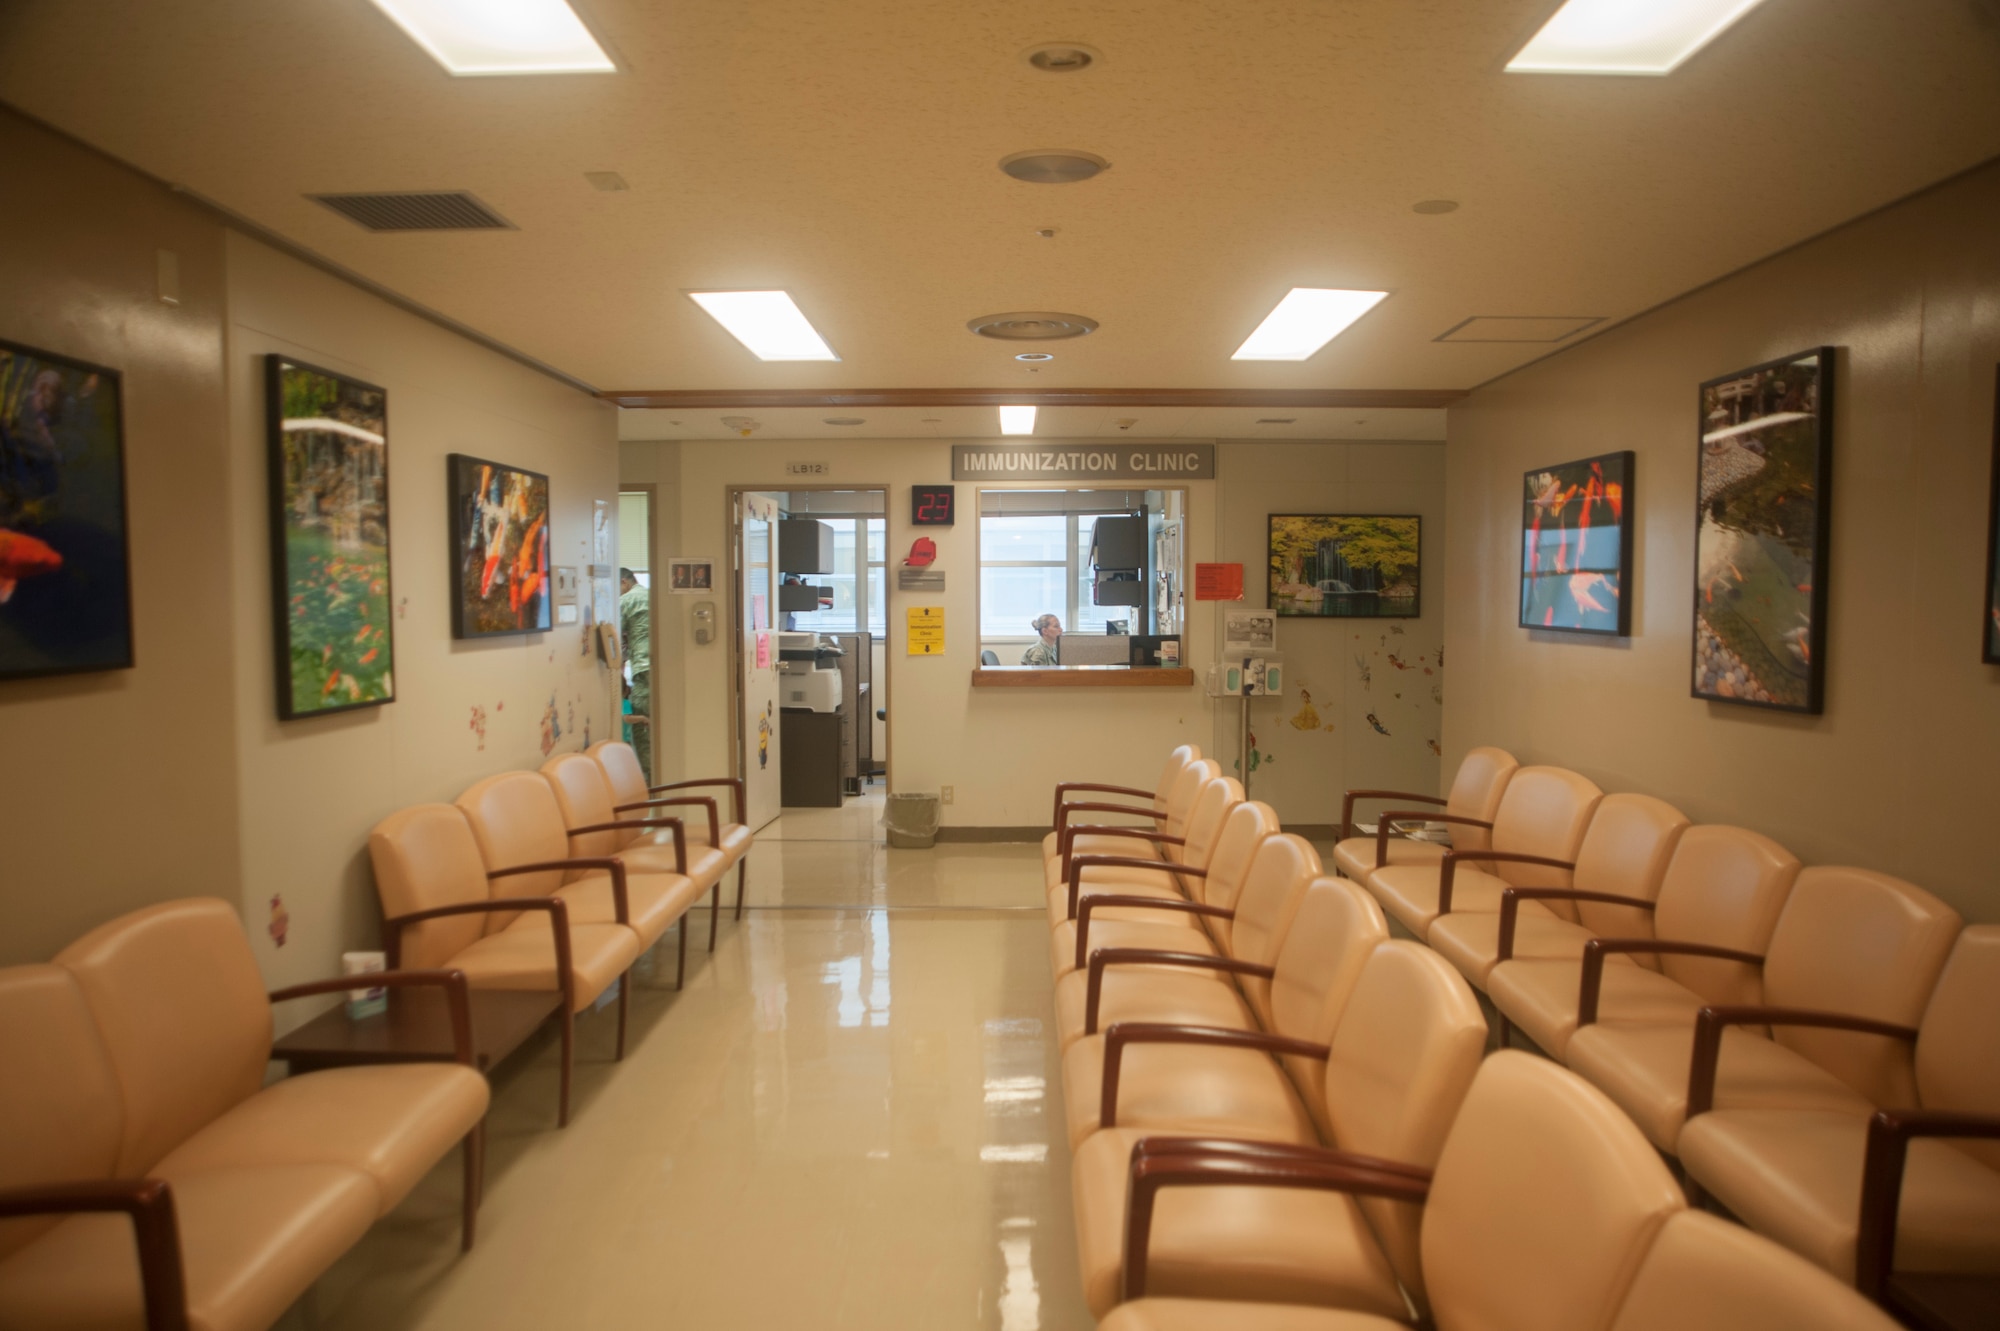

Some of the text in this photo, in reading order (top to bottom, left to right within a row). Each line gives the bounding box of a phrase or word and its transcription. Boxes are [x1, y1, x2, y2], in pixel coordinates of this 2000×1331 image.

[792, 464, 822, 474] LB12
[963, 452, 1199, 471] IMMUNIZATION CLINIC
[917, 493, 950, 521] 23
